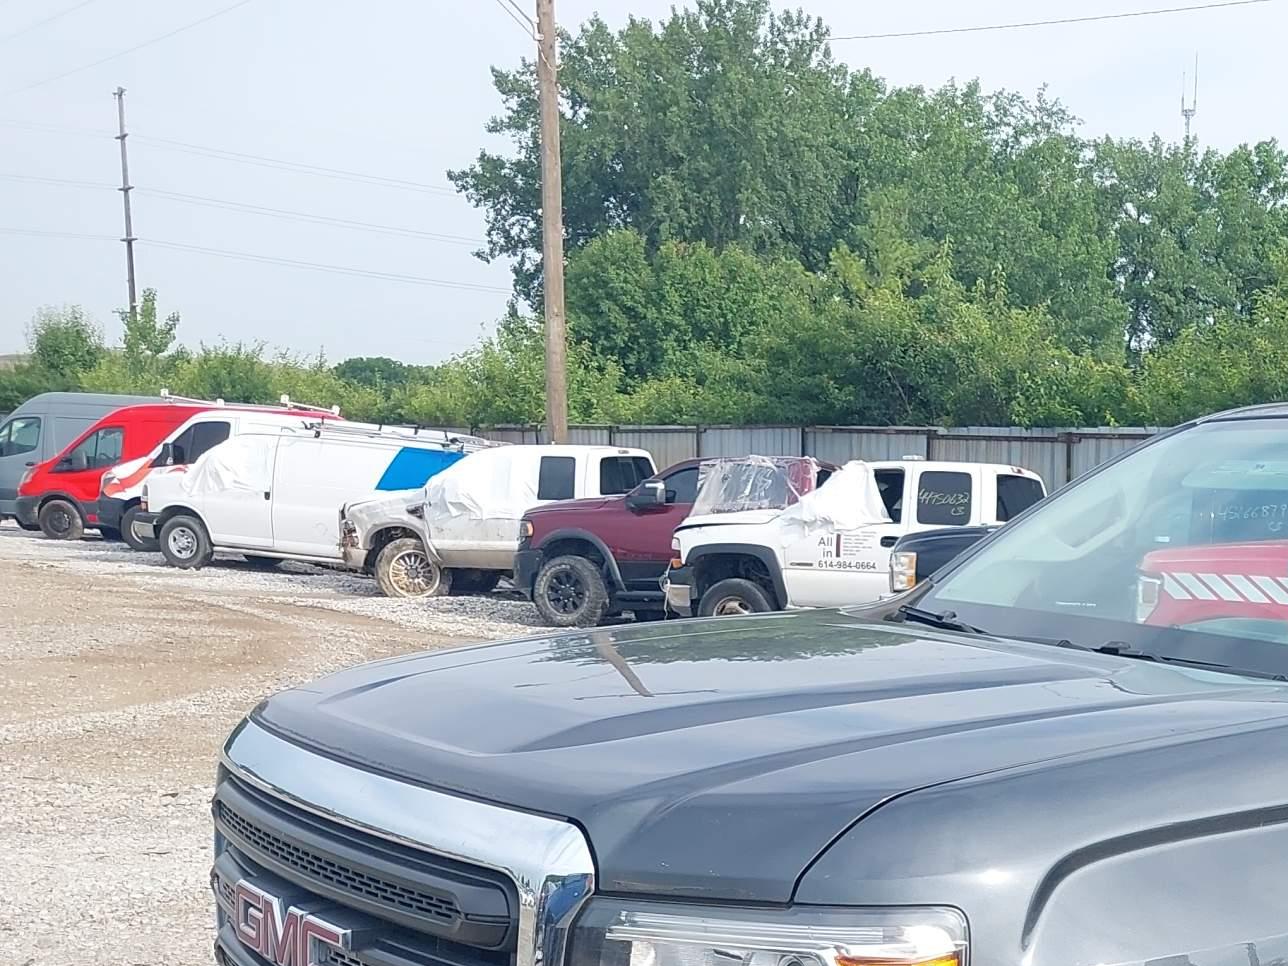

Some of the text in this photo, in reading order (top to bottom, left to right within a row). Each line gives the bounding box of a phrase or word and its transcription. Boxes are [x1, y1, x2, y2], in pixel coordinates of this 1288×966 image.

[818, 536, 833, 547] All
[822, 547, 833, 558] in
[818, 560, 877, 570] 614-984-0664
